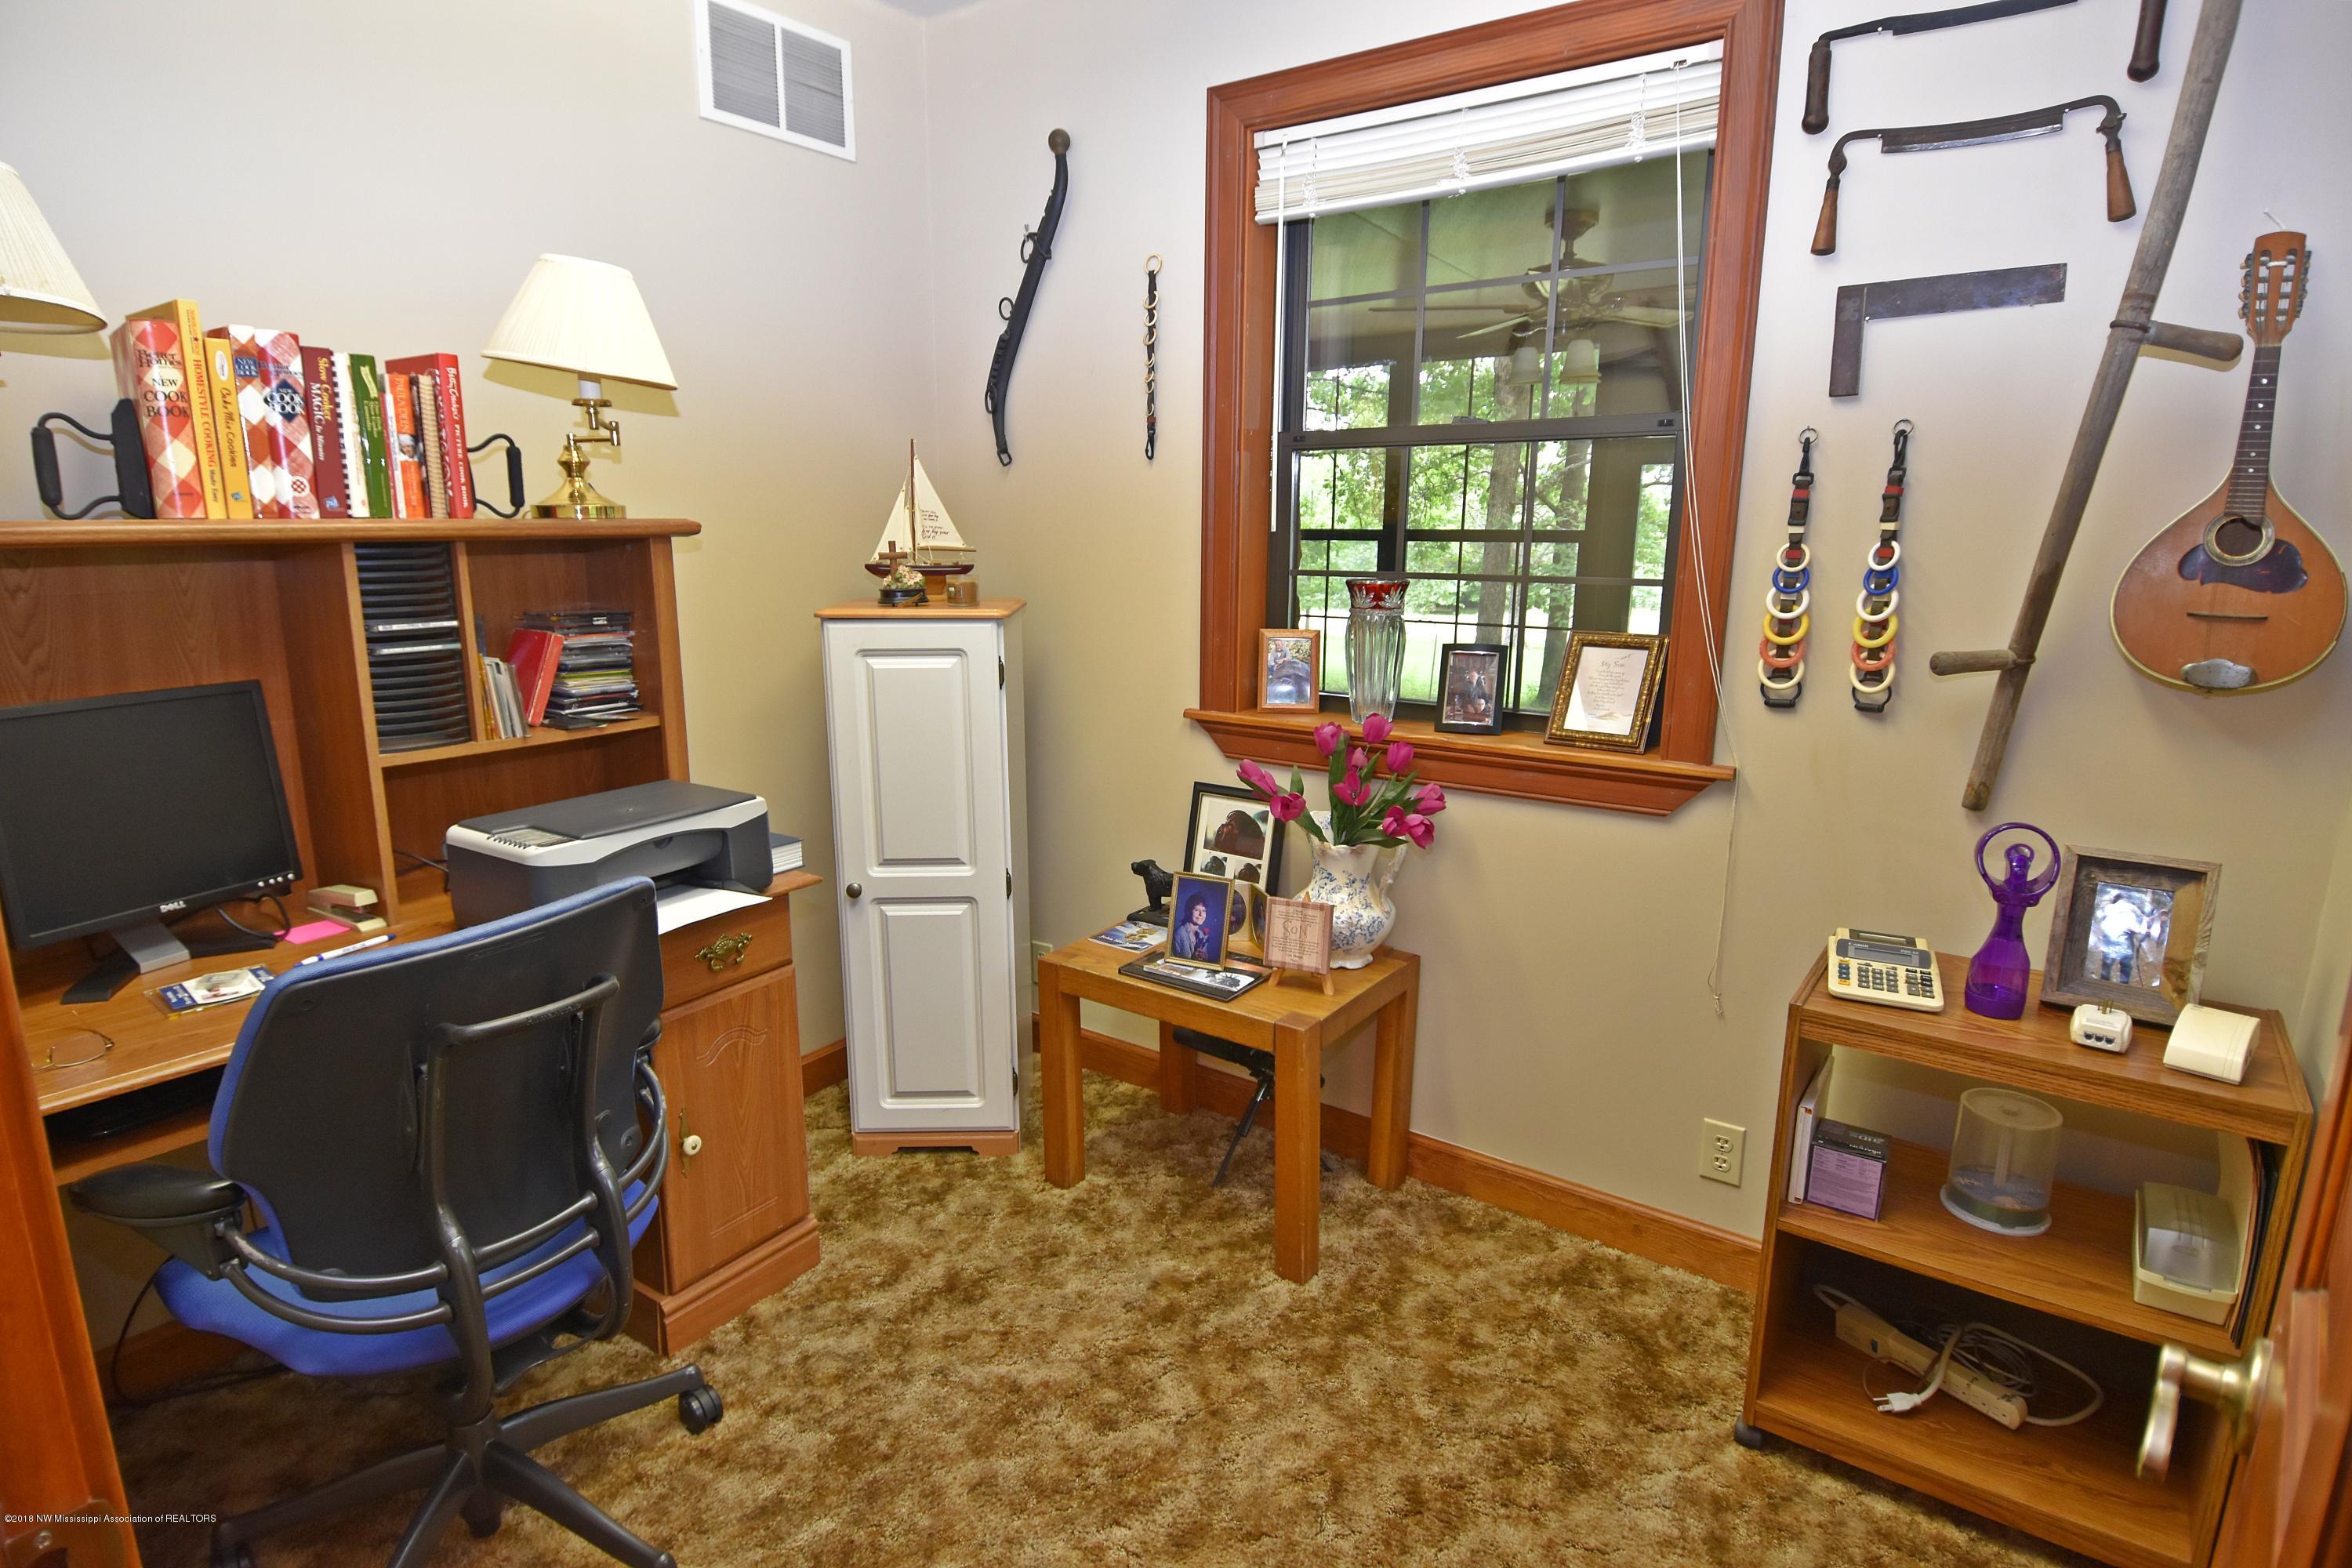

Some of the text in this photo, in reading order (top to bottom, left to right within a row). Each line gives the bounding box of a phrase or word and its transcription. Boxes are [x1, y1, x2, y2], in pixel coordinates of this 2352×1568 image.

[152, 377, 178, 387] NEW
[445, 367, 458, 389] Betty
[143, 390, 188, 403] COOK
[220, 387, 232, 409] Cake
[267, 392, 305, 405] COOK
[318, 357, 335, 421] Slow Cooker
[146, 405, 191, 419] BOOK
[193, 359, 209, 419] HOMESTYLE
[201, 421, 216, 467] COOKING
[269, 401, 307, 416] BOOK
[310, 383, 326, 425] MAGIC
[448, 388, 461, 420] Crocker's
[223, 411, 235, 428] Mix
[226, 431, 238, 467] Cookies
[159, 901, 187, 913] DELL
